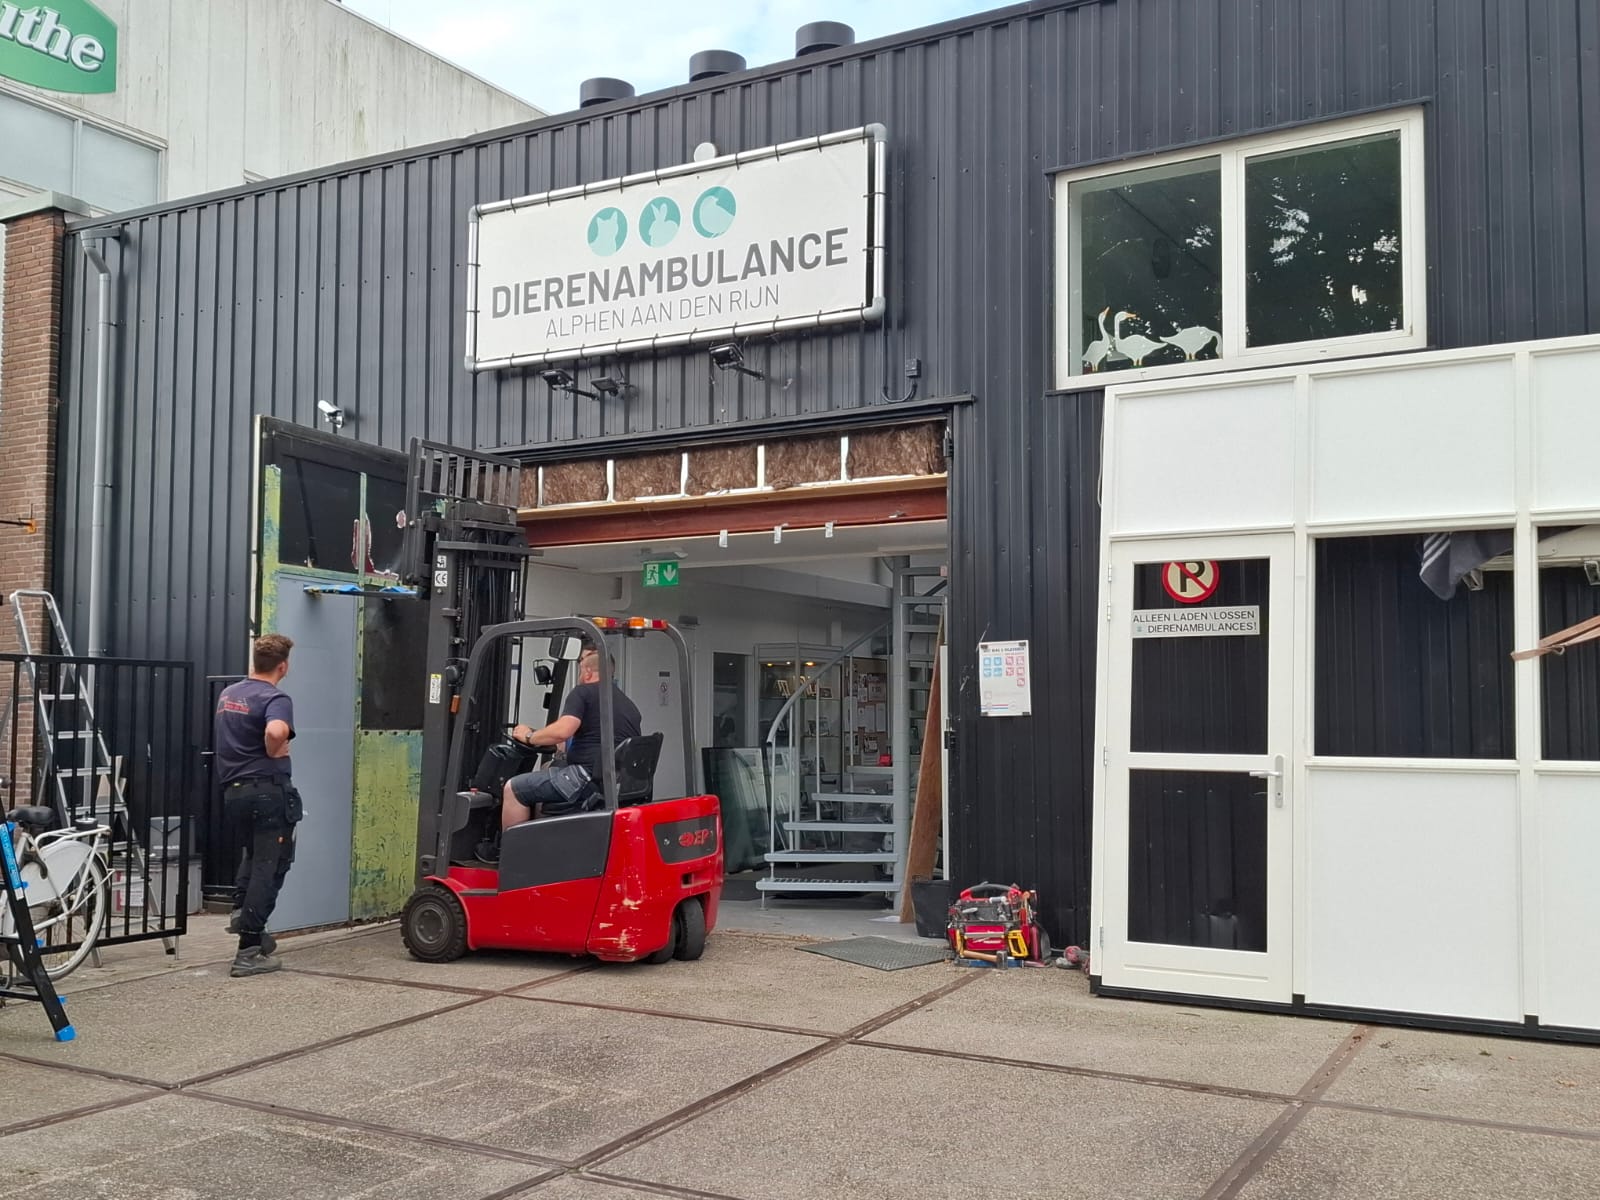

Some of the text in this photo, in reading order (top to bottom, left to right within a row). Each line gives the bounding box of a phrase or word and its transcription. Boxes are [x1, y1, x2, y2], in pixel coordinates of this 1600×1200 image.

[491, 227, 849, 319] DIERENAMBULANCE
[545, 284, 780, 339] ALPHEN AAN DEN RIJN
[1133, 613, 1171, 624] ALLEEN
[1148, 622, 1257, 633] DIERENAMBULANCES!
